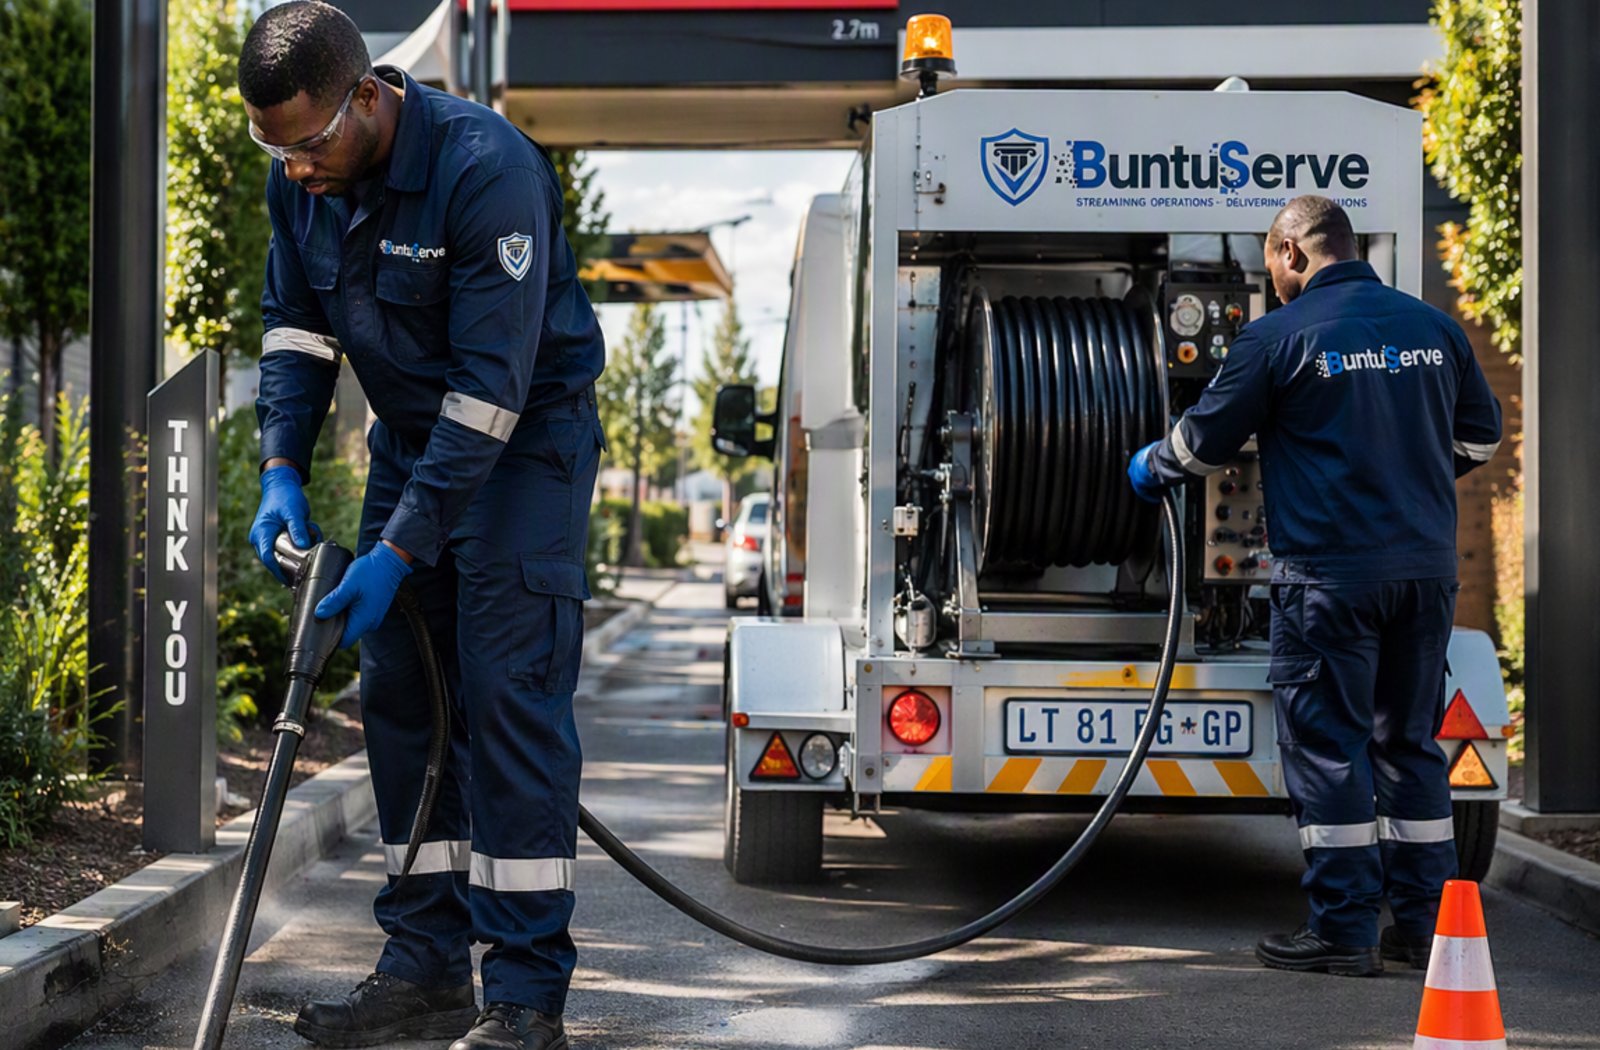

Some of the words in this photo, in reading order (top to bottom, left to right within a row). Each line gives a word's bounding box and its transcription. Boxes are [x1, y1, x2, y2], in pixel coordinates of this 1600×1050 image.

[832, 19, 879, 40] 2.7m
[1073, 140, 1369, 190] BuntuServe
[1226, 197, 1286, 207] DELIVERING
[1322, 346, 1443, 375] BuntuServe
[166, 420, 189, 571] THNK
[165, 600, 188, 706] YOU
[1019, 708, 1059, 744] LT
[1077, 708, 1117, 744] 81
[1203, 710, 1241, 746] GP
